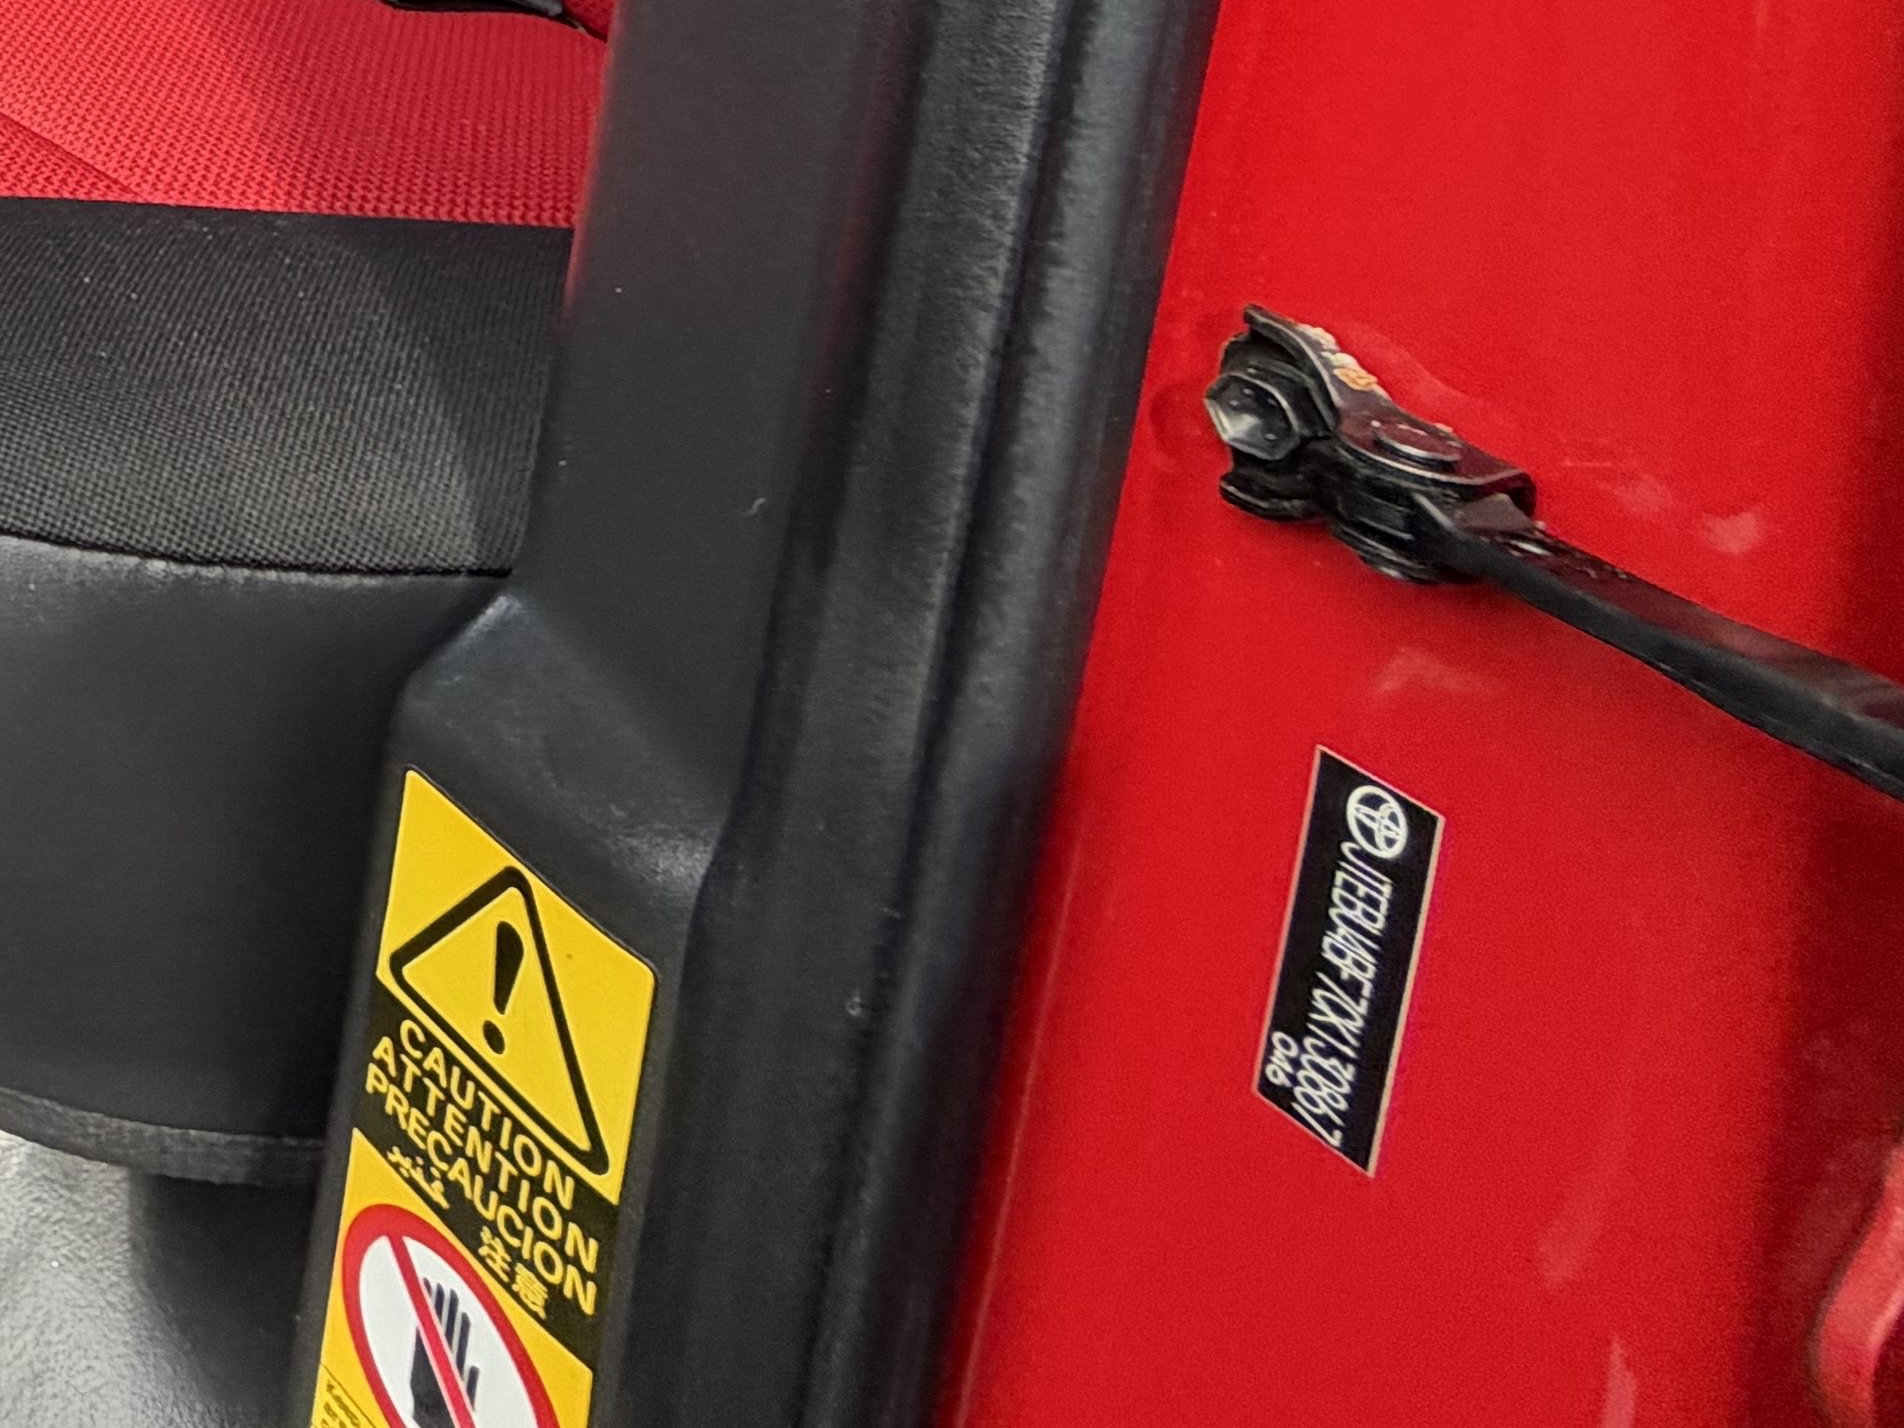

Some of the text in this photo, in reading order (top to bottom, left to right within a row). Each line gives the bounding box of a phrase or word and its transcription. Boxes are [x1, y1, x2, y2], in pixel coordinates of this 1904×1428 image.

[1290, 840, 1394, 1149] JTEBU4BF7CK130867
[365, 1061, 597, 1316] PRECAUCION
[372, 1035, 599, 1274] ATTENTION
[399, 1018, 575, 1211] CAUTION
[477, 1224, 548, 1320] 注意
